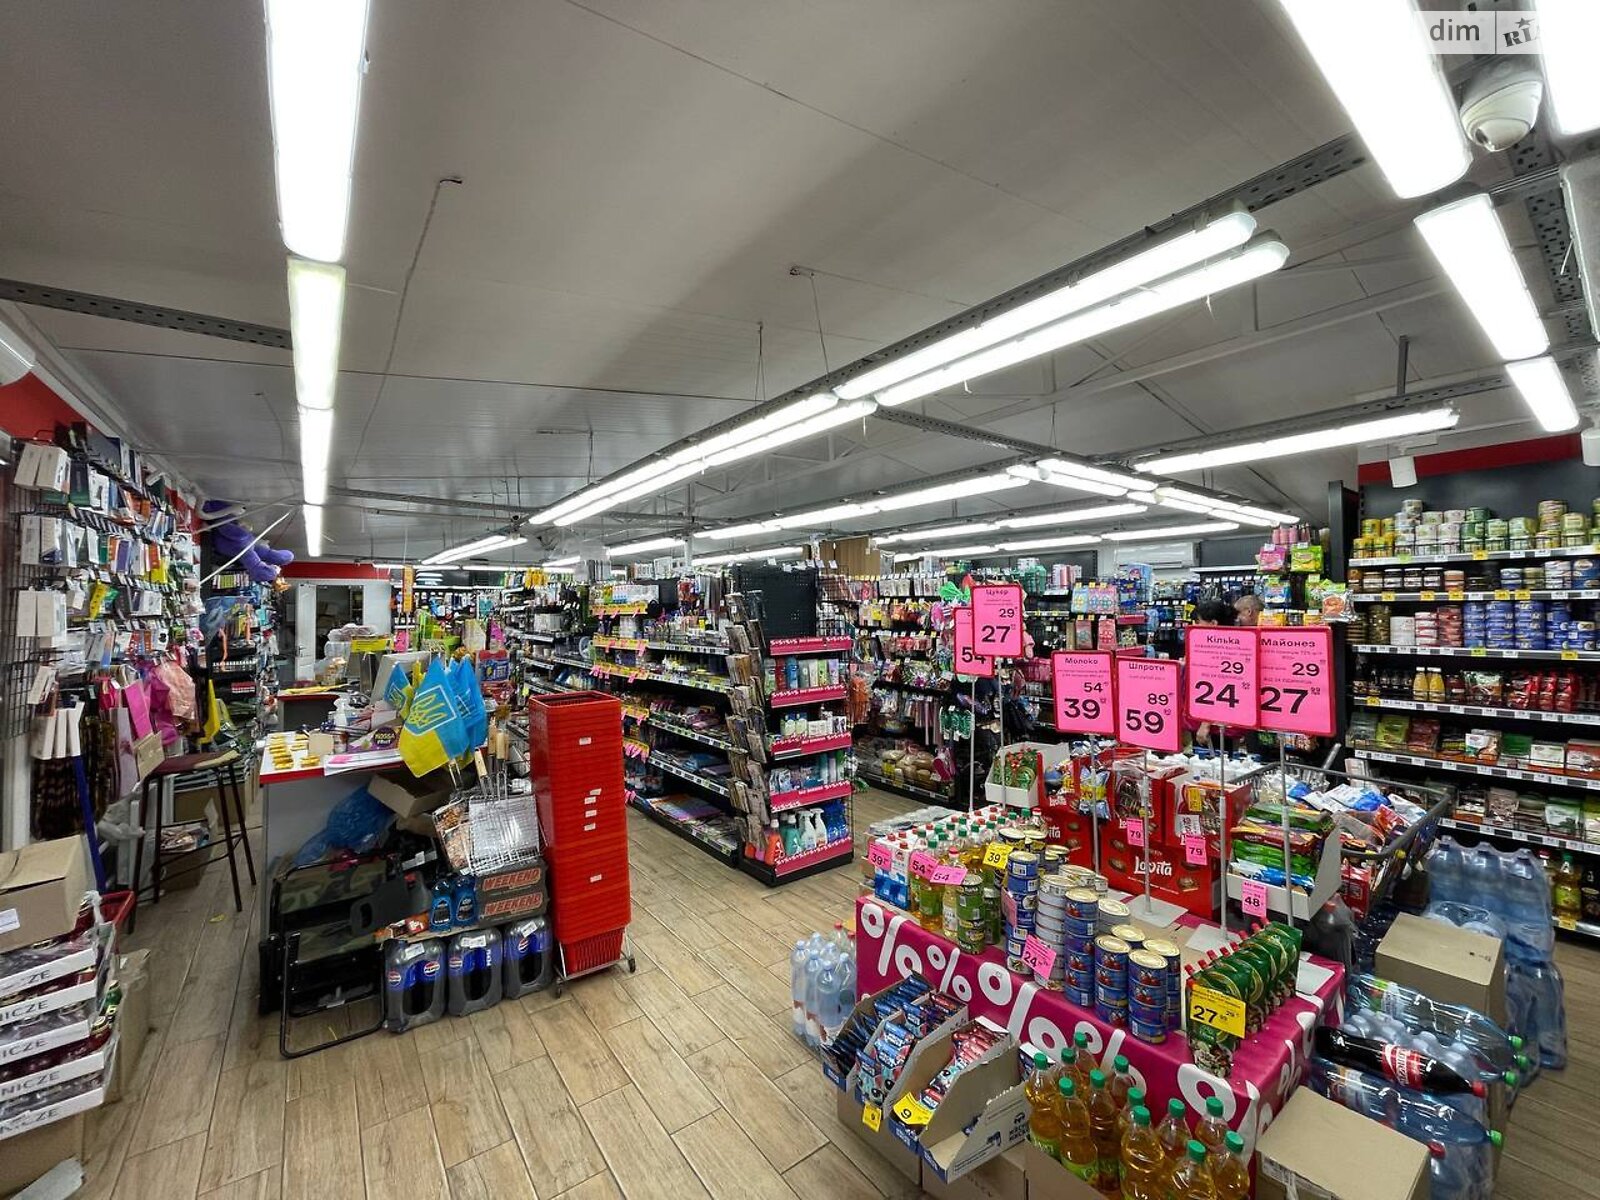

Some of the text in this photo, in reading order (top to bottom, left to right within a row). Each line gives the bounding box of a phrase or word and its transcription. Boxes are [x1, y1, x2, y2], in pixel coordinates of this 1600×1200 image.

[998, 607, 1015, 618] 29
[981, 624, 1011, 643] 27
[1206, 635, 1240, 645] Кілька
[1260, 638, 1316, 648] Майонез
[1064, 657, 1099, 665] Молоко
[1128, 662, 1165, 672] Шпроти
[1220, 660, 1244, 675] 29
[1291, 662, 1320, 677] 29
[1083, 681, 1104, 693] 54
[1194, 680, 1240, 709] 24
[1147, 692, 1169, 706] 89
[1259, 685, 1309, 715] 27
[1063, 697, 1101, 720] 39
[1126, 708, 1164, 734] 59
[1129, 830, 1142, 840] 79
[871, 852, 884, 867] 39
[988, 851, 1002, 864] 39
[1188, 847, 1204, 857] 79
[911, 859, 927, 875] 54
[483, 869, 540, 891] WEEKEND
[485, 892, 542, 915] WEEKEND
[1244, 895, 1261, 908] 48
[1022, 951, 1038, 968] 24
[1193, 1004, 1219, 1024] 27
[1, 1069, 61, 1097] NICZE
